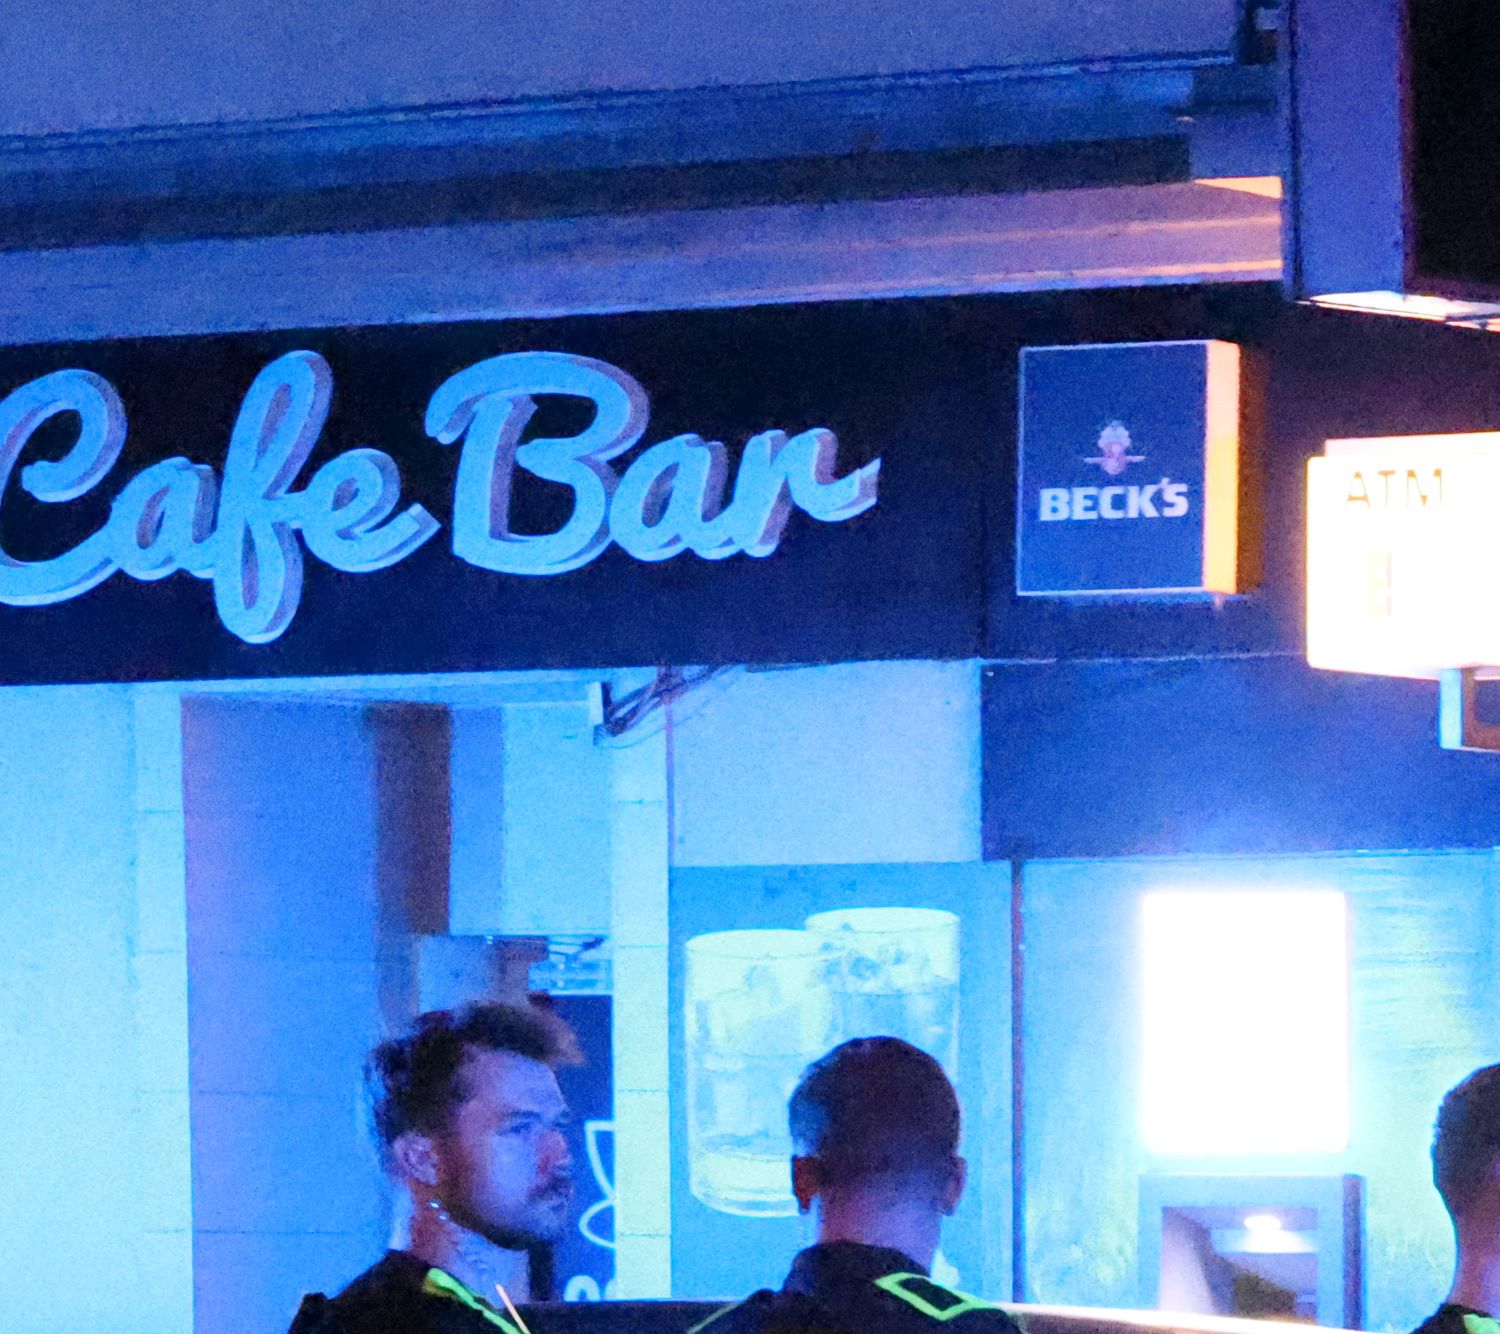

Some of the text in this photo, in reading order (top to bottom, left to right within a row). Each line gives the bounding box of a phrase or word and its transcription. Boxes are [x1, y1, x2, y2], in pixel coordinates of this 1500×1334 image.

[0, 349, 880, 645] Cafe Bar
[1039, 477, 1189, 521] BECK'S
[1344, 468, 1444, 511] ATM
